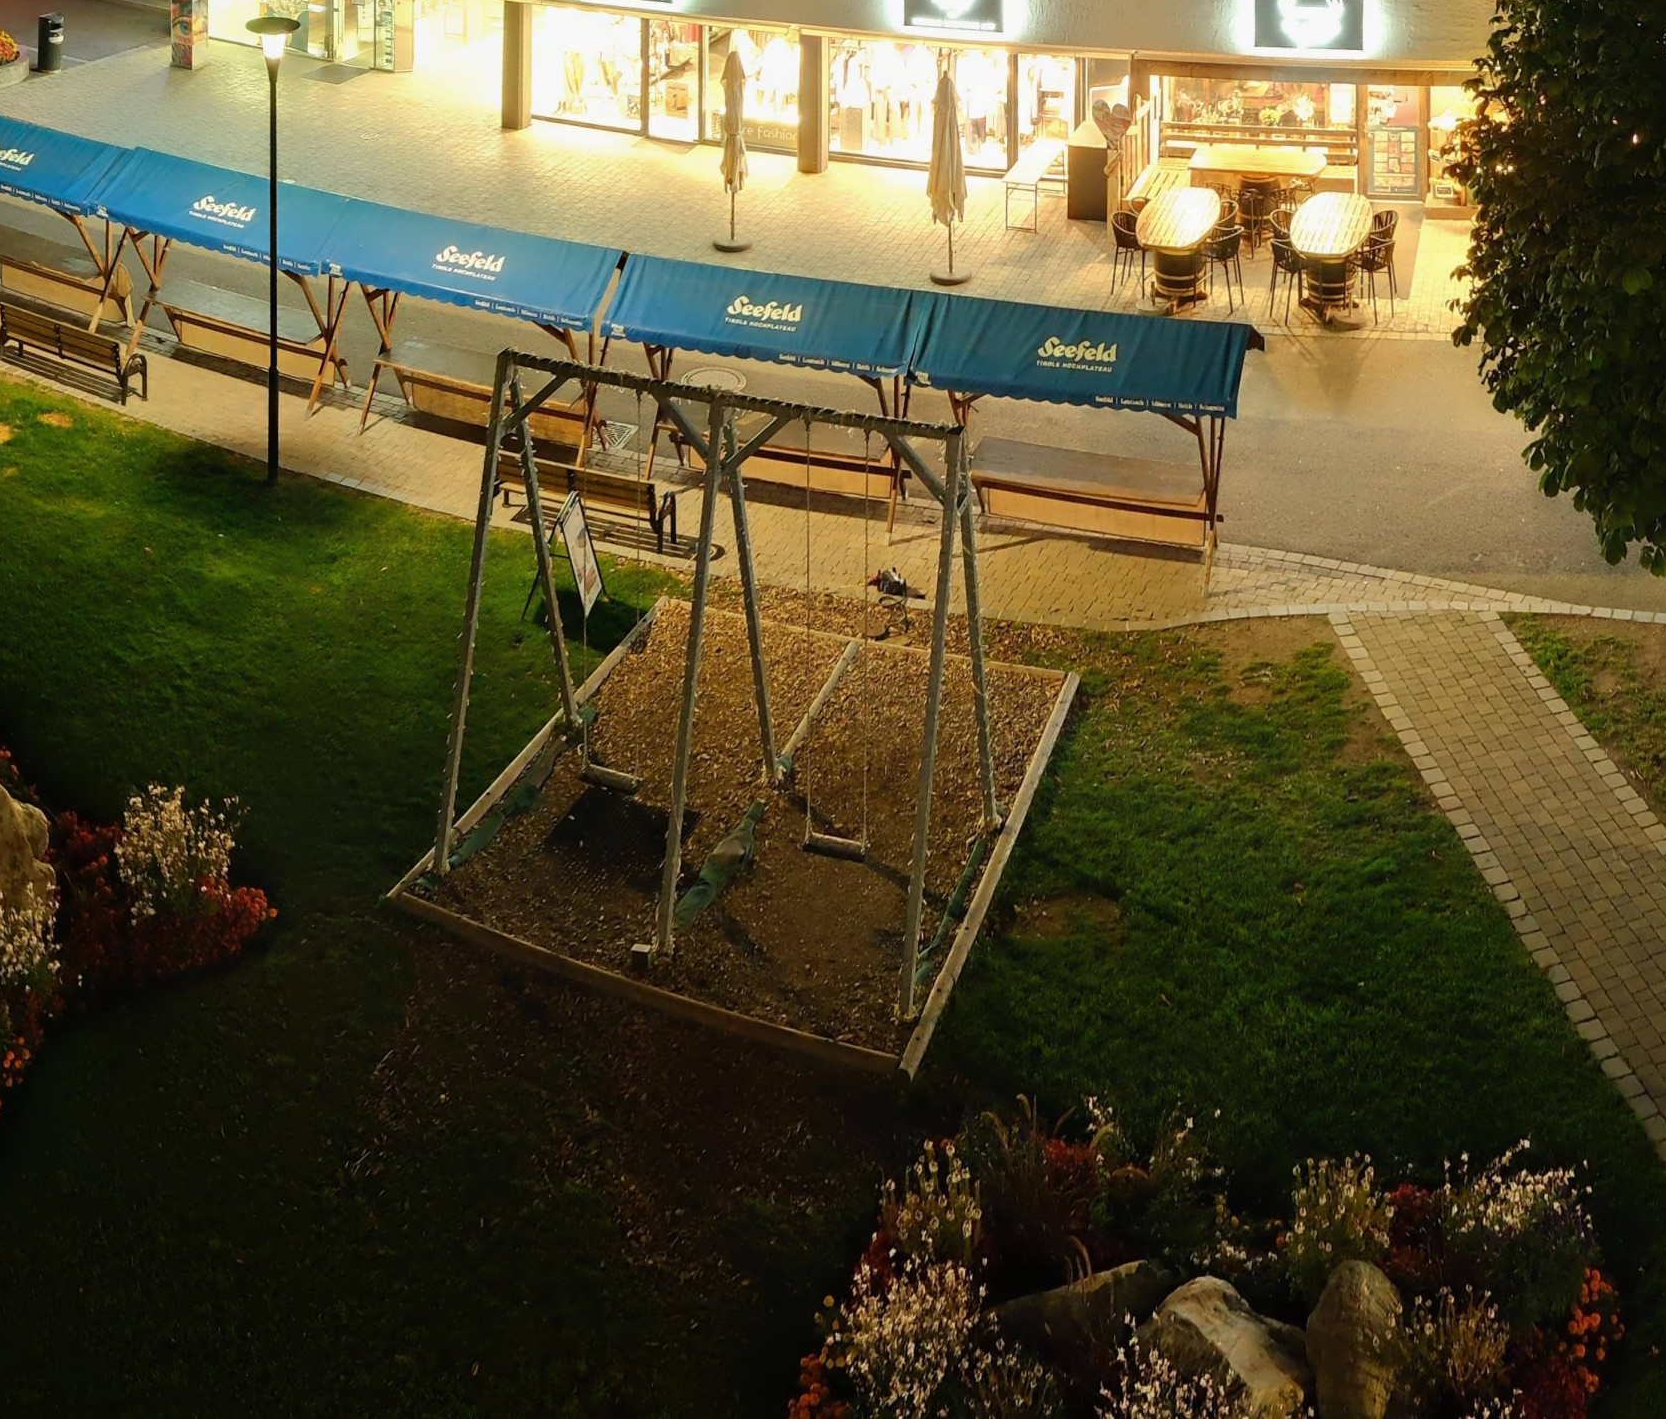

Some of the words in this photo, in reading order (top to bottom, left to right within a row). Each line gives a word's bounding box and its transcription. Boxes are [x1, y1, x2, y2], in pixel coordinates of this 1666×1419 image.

[193, 194, 257, 223] Seefeld
[435, 245, 506, 273] Seefeld
[726, 294, 803, 323] Seefeld
[1037, 335, 1118, 363] Seefeld
